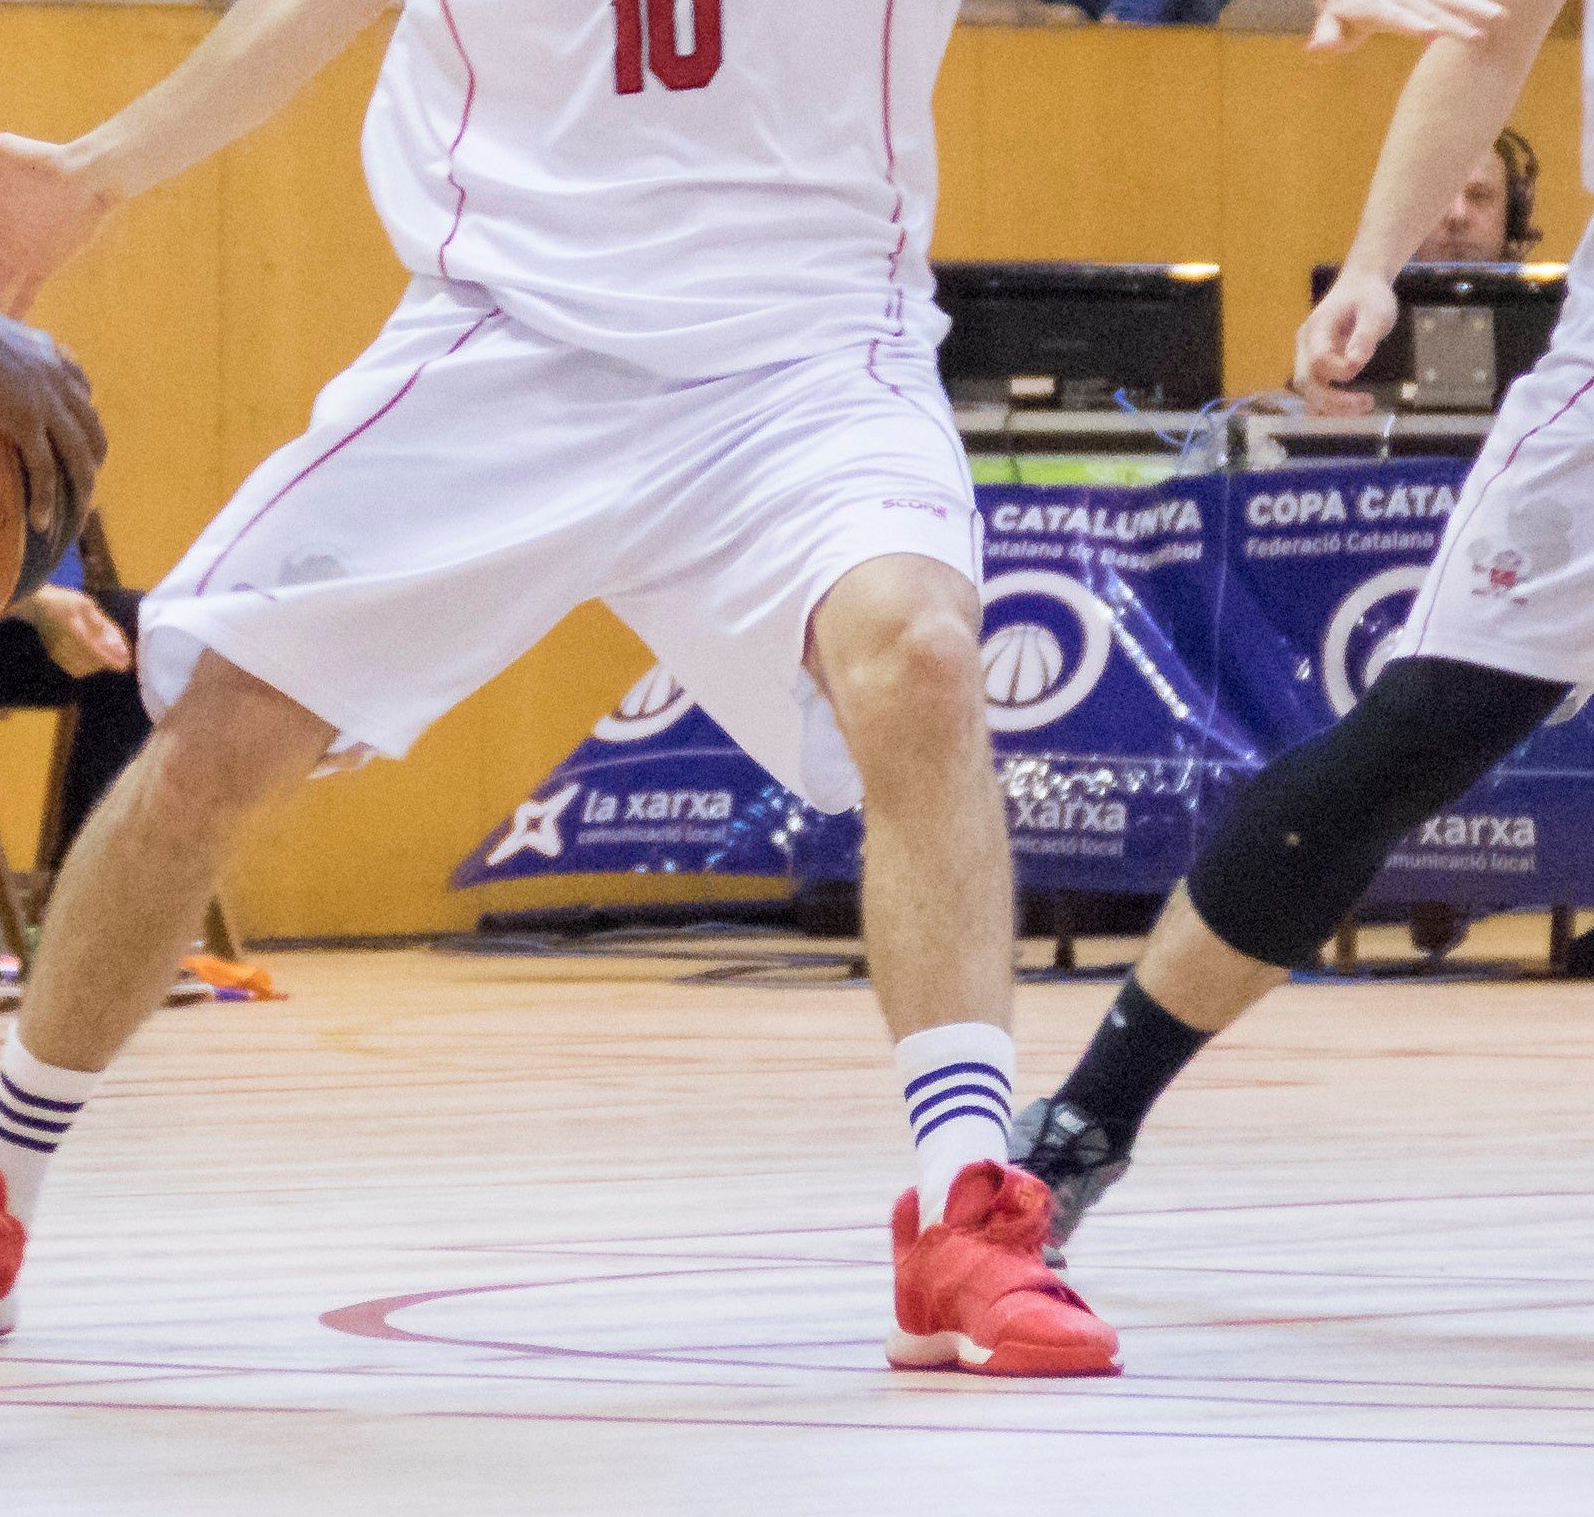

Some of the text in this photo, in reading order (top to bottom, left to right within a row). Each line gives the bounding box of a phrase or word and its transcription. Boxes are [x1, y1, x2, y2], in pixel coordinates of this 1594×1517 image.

[992, 500, 1202, 541] CATALUNYA
[1247, 484, 1460, 526] COPA CATA
[986, 541, 1064, 559] atalana
[1246, 533, 1341, 558] Federació
[583, 790, 733, 823] la xarxa
[1015, 798, 1127, 831] xarxa
[1419, 814, 1537, 848] xarxa
